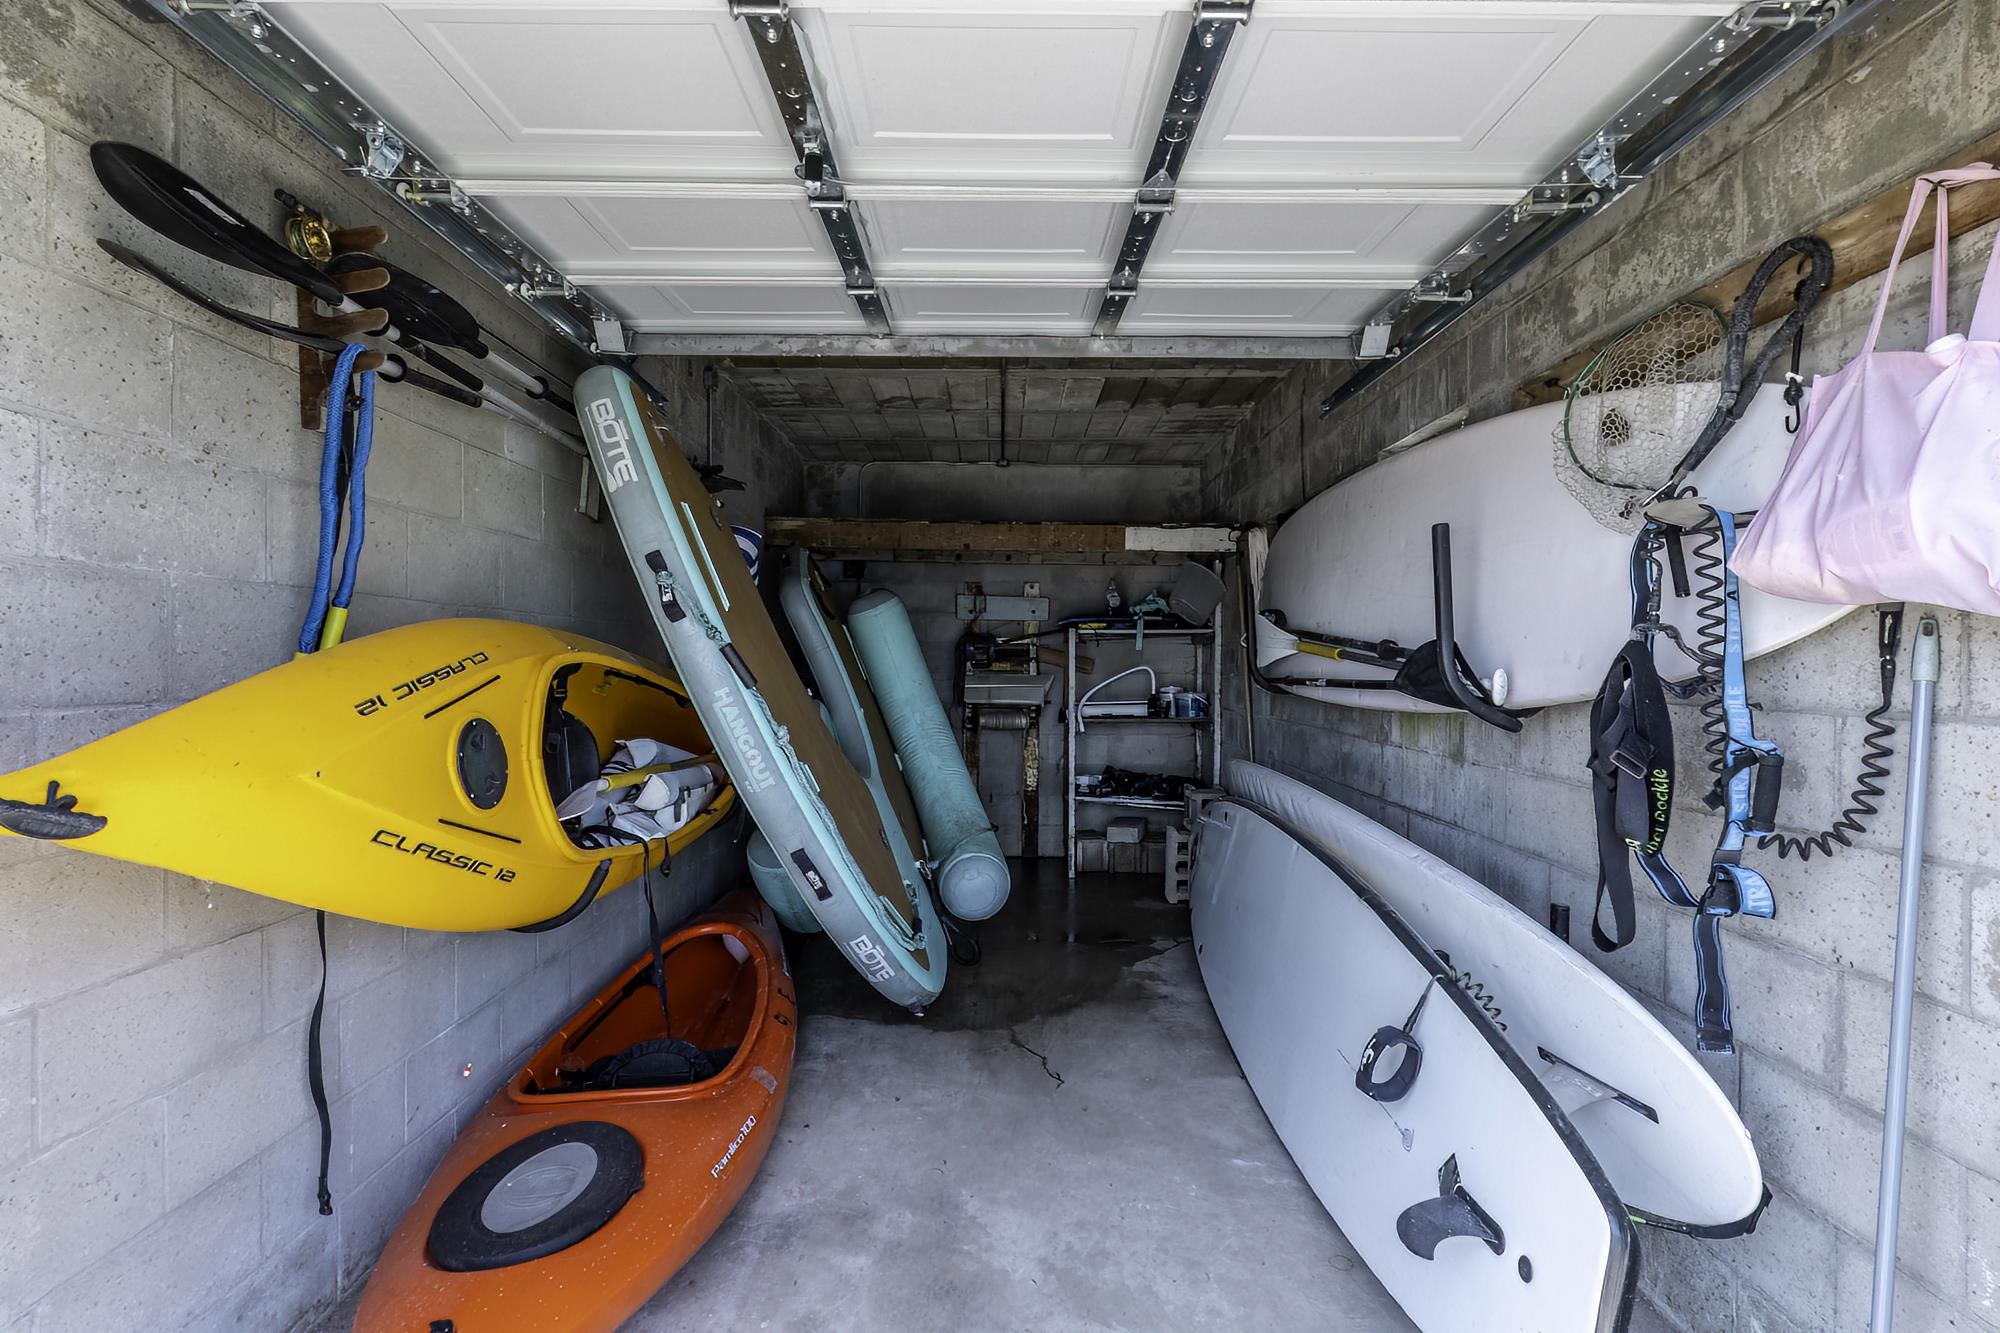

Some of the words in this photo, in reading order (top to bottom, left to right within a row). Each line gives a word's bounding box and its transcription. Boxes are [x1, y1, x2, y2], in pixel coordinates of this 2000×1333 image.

[391, 651, 489, 701] CLASSIC
[354, 694, 388, 716] 12
[711, 686, 776, 791] HANGOUT
[370, 829, 493, 876] CLASSIC
[494, 867, 516, 883] 12
